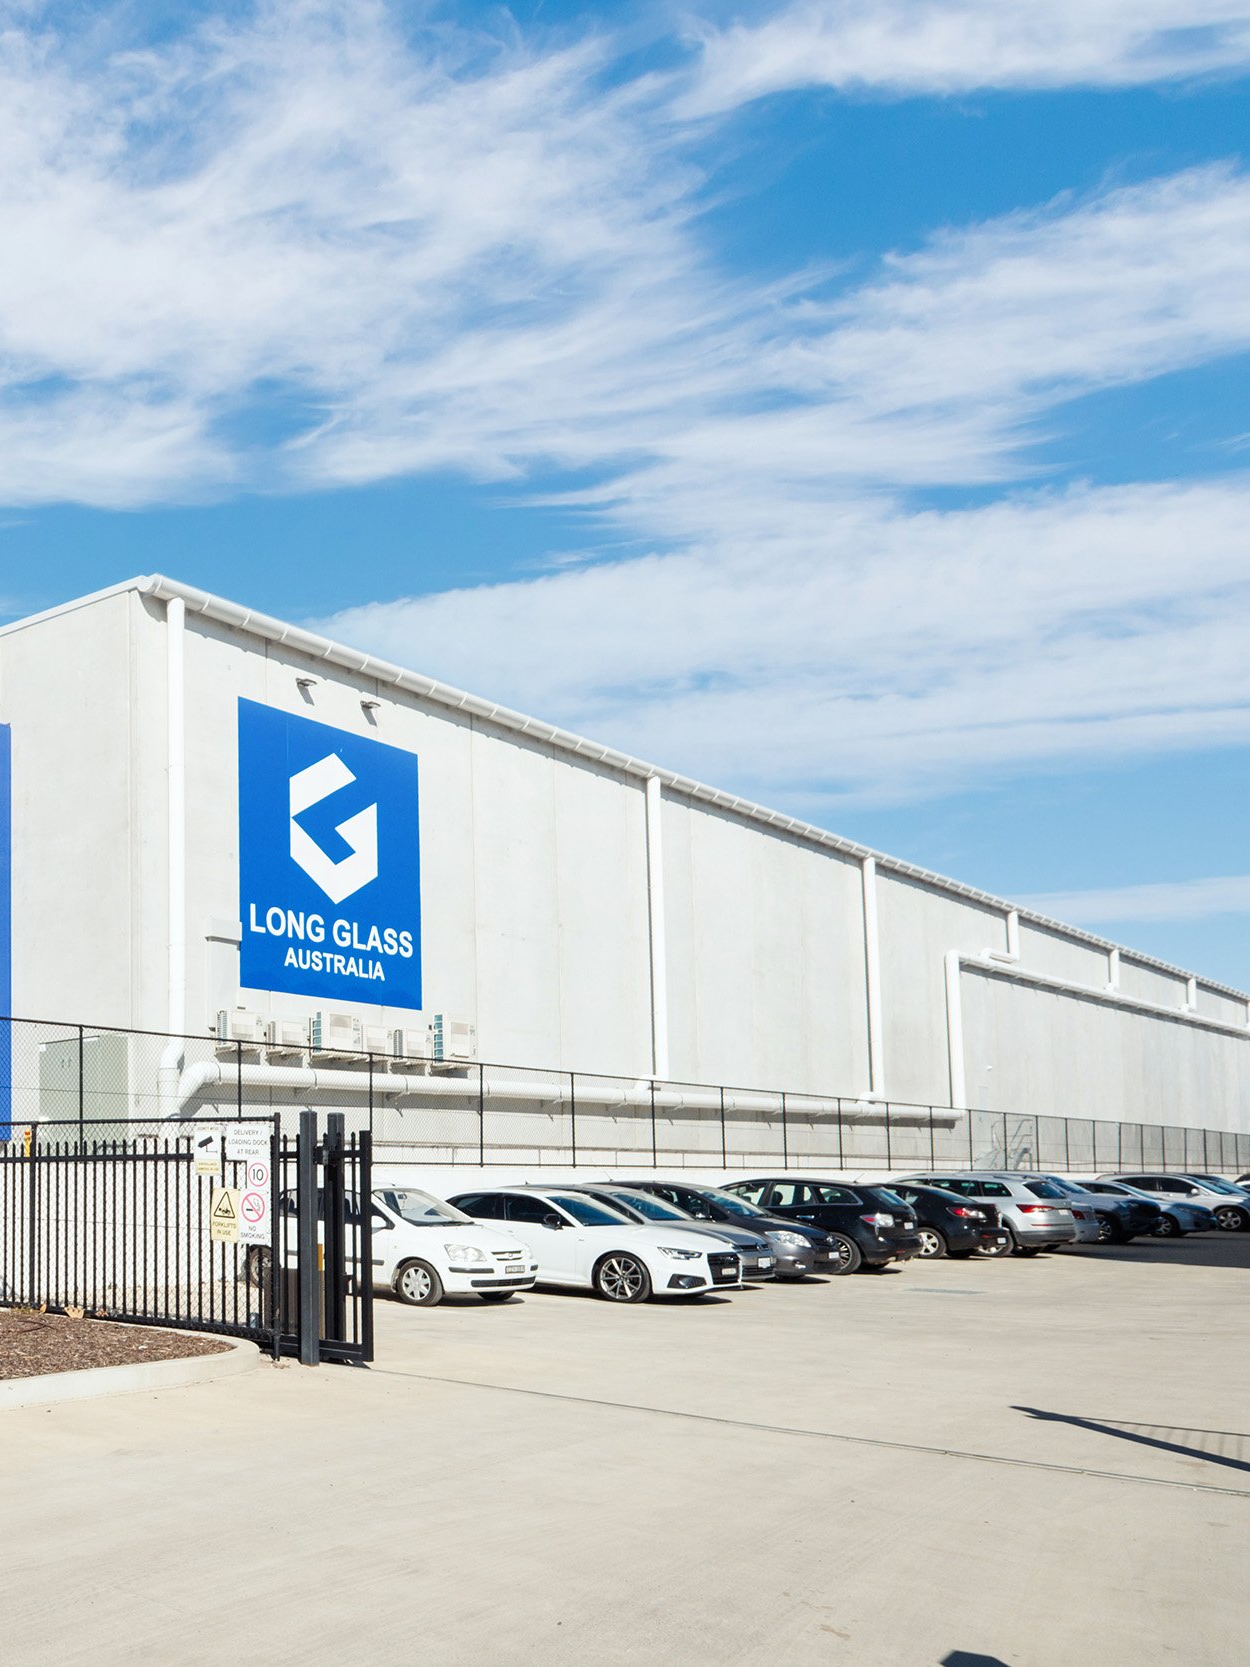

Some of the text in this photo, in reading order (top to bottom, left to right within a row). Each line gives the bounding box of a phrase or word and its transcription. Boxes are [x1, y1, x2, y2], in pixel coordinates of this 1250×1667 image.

[250, 903, 414, 958] LONG GLASS
[284, 947, 385, 981] AUSTRALIA
[252, 1168, 264, 1181] 10
[212, 1221, 237, 1230] FORKLIFTS
[240, 1232, 265, 1240] SMOKING
